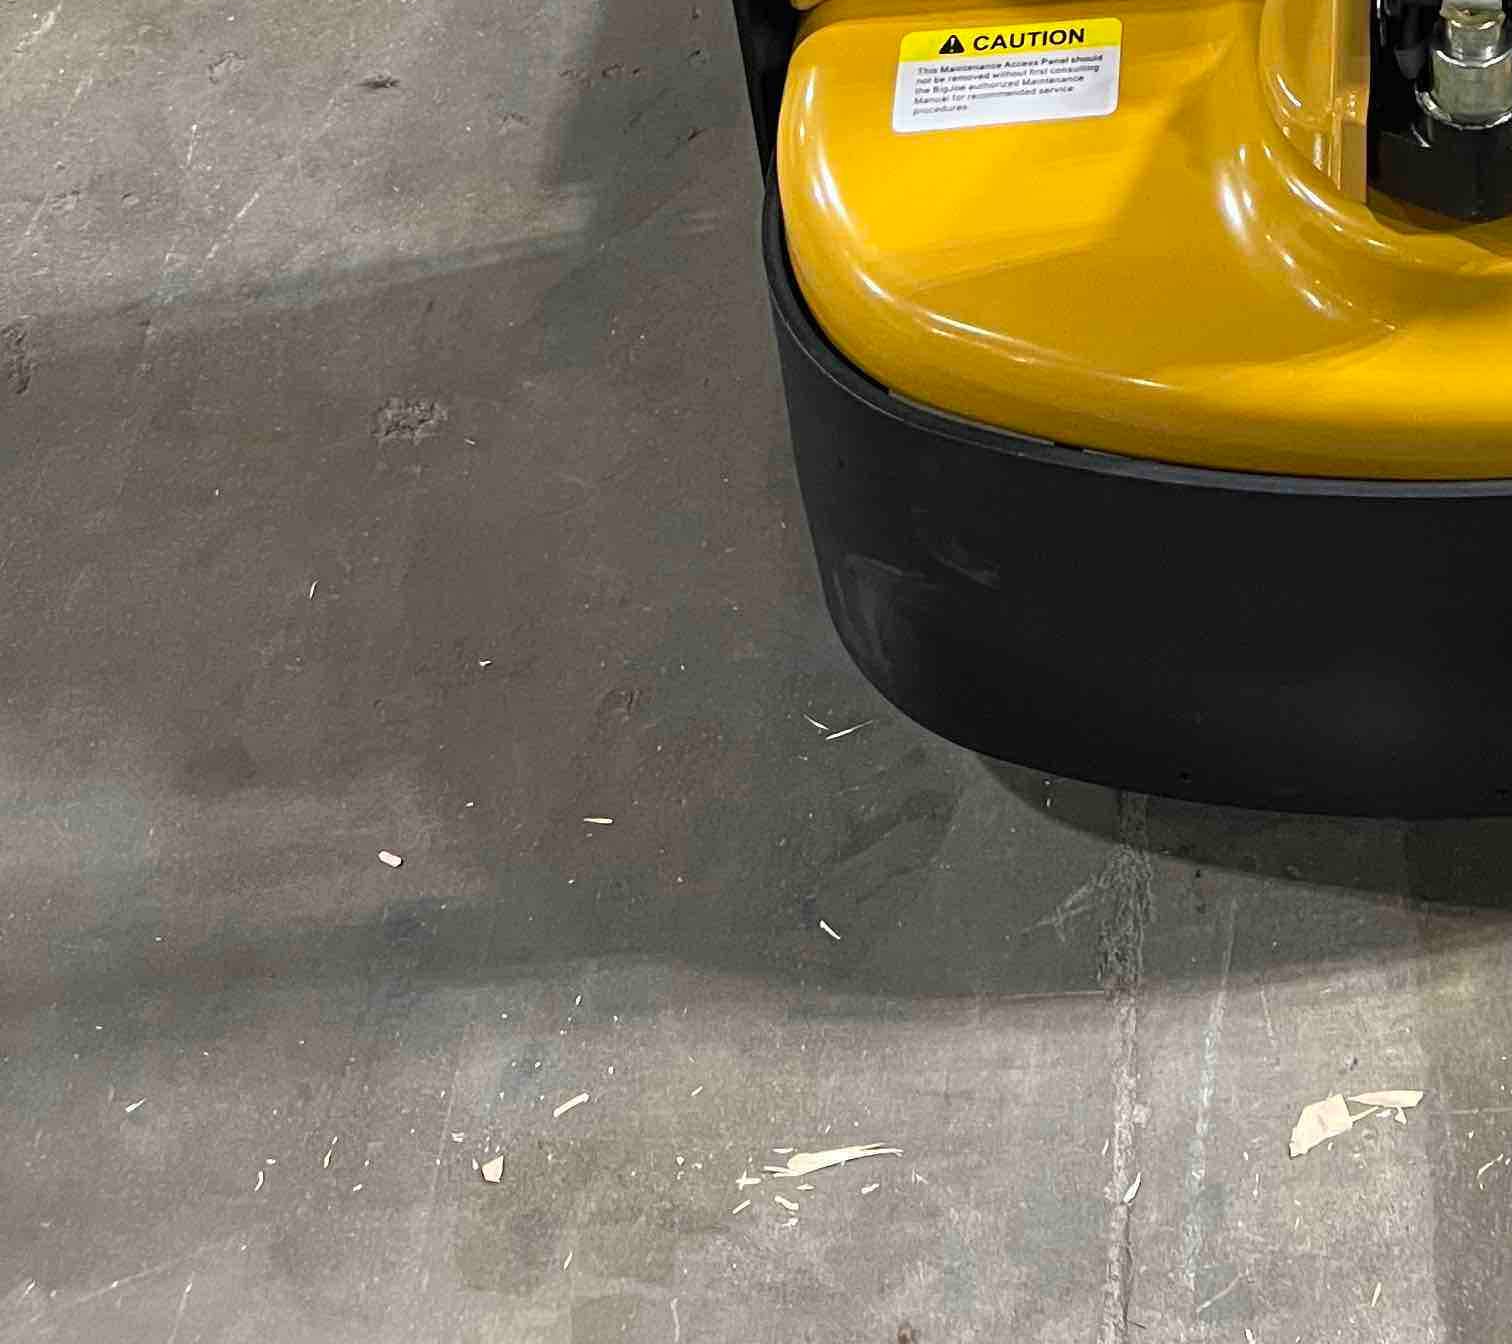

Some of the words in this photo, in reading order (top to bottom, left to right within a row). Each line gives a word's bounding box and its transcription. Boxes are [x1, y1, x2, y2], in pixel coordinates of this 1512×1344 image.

[973, 27, 1086, 51] CAUTION
[916, 76, 932, 84] not
[934, 75, 945, 83] be
[947, 72, 990, 82] removed
[992, 69, 1027, 78] without
[1029, 67, 1048, 75] first
[1050, 64, 1100, 75] consulting
[918, 66, 937, 75] This
[940, 63, 1002, 73] Maintenance
[1005, 59, 1038, 68] Access
[1041, 56, 1069, 65] Panel
[1071, 54, 1103, 63] should
[914, 86, 930, 94] the
[968, 80, 1020, 90] authorized
[1022, 75, 1085, 86] Maintenance
[952, 93, 965, 102] for
[968, 89, 1037, 100] rended
[1038, 85, 1074, 94] service
